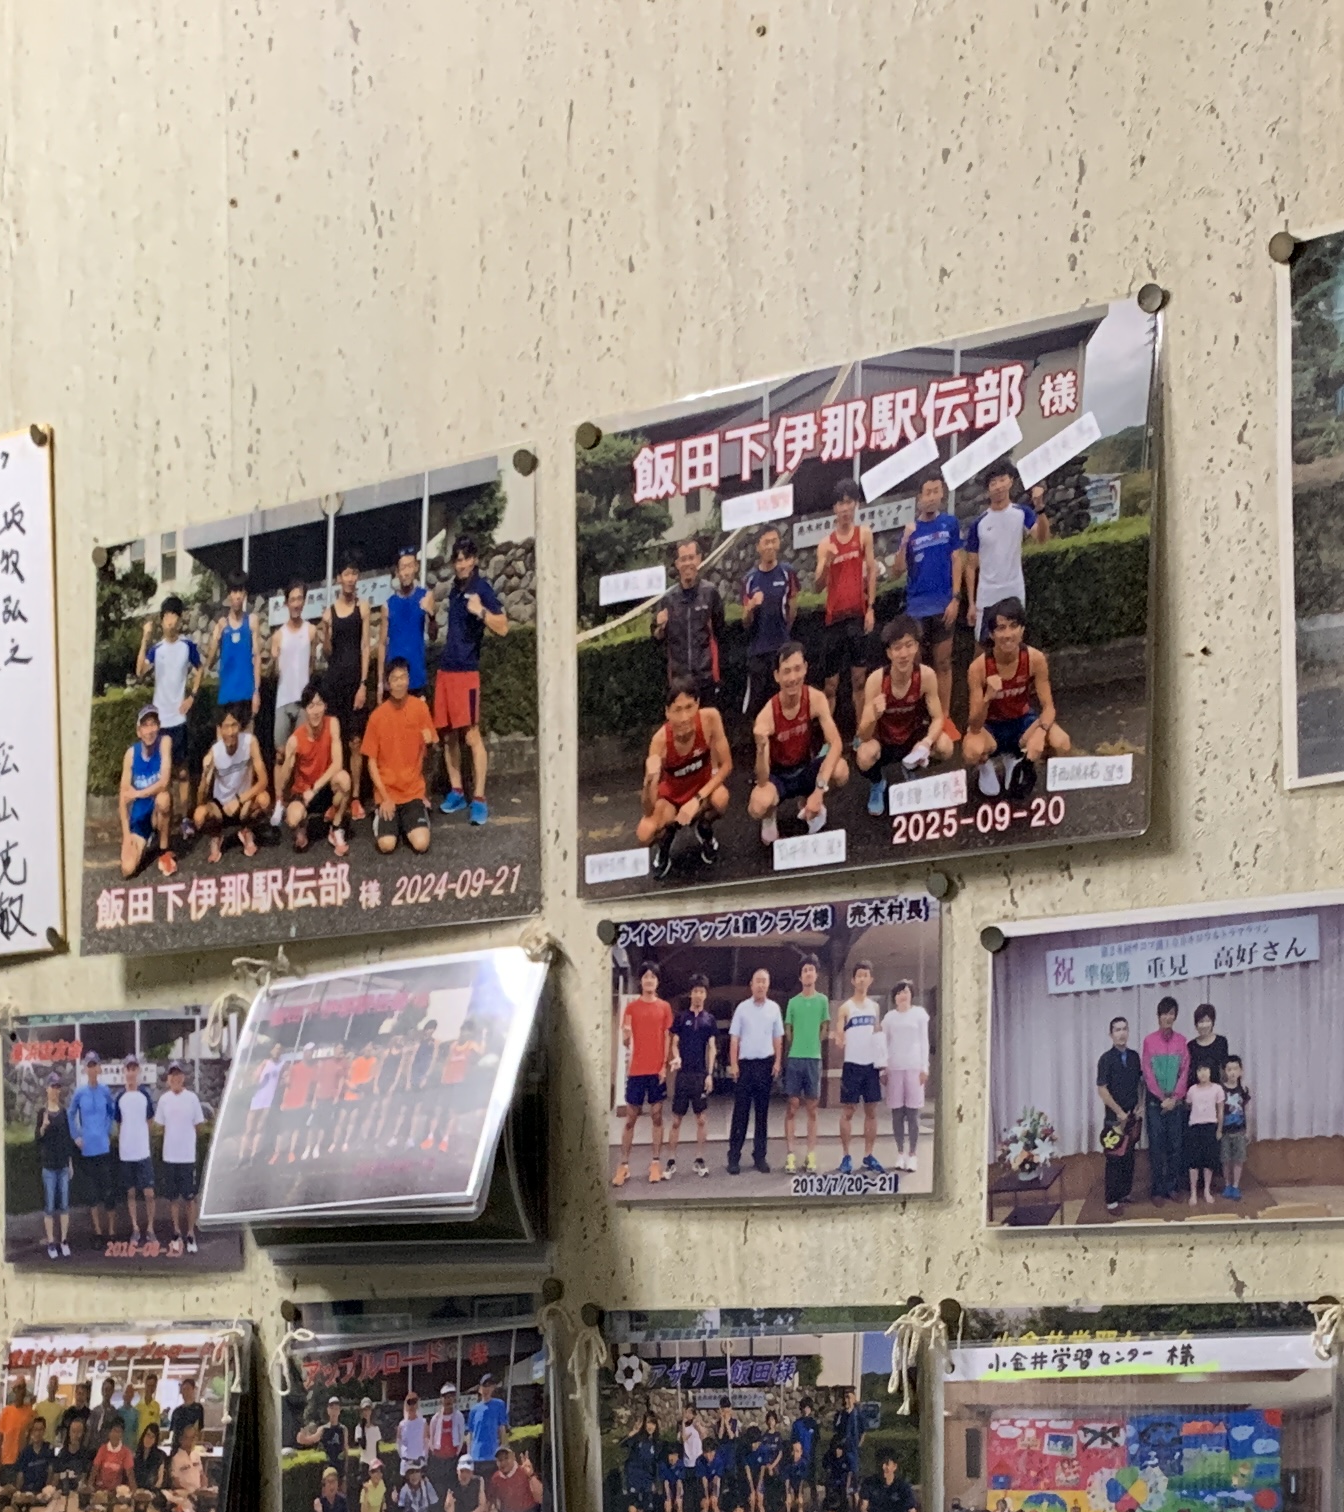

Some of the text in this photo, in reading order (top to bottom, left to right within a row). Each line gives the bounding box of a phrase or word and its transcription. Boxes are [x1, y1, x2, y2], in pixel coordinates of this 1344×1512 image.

[633, 362, 1025, 502] 飯田下伊那駅伝部
[1039, 369, 1079, 419] 様
[891, 794, 1066, 845] 2025-09-20
[95, 862, 522, 930] 飯田下伊那駅伝部 様 2024-09-21
[1052, 955, 1076, 987] 祝
[988, 1343, 1195, 1372] 小金井学習センター 様
